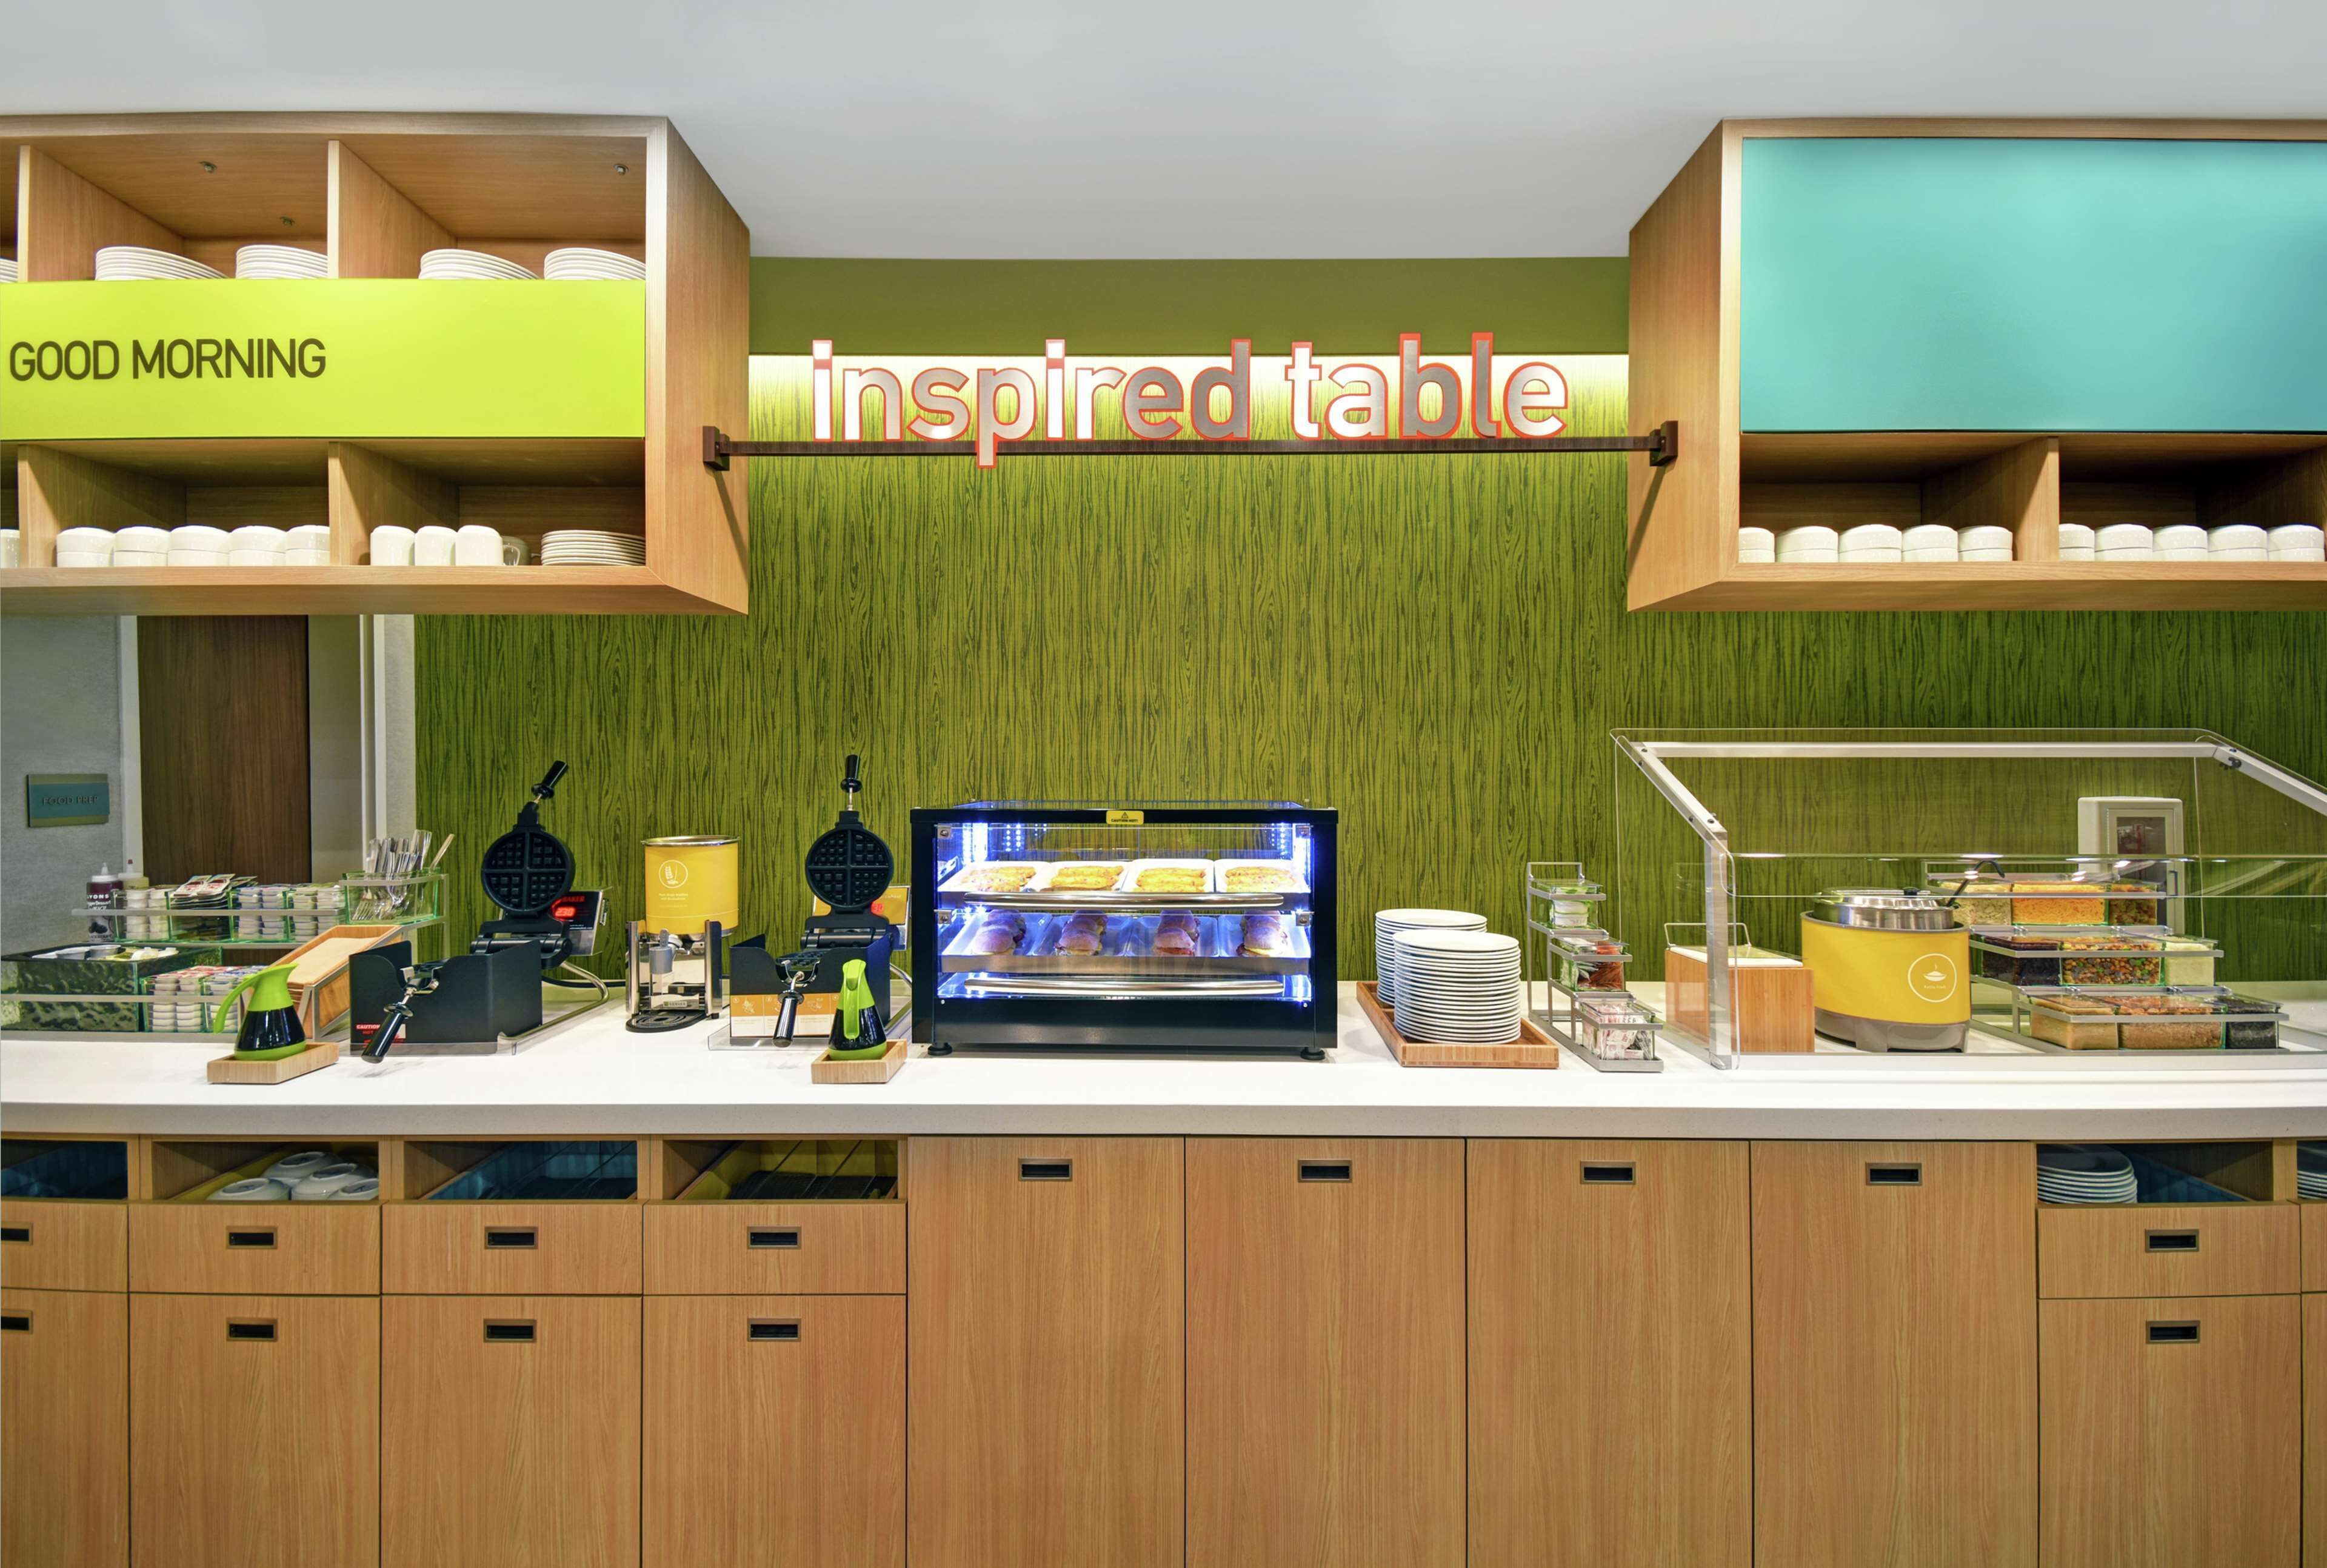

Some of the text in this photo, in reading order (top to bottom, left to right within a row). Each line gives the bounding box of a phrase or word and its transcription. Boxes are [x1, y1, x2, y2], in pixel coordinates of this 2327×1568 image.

[10, 338, 326, 381] GOOD MORNING
[812, 332, 1568, 469] inspired table
[42, 796, 73, 806] FOOD
